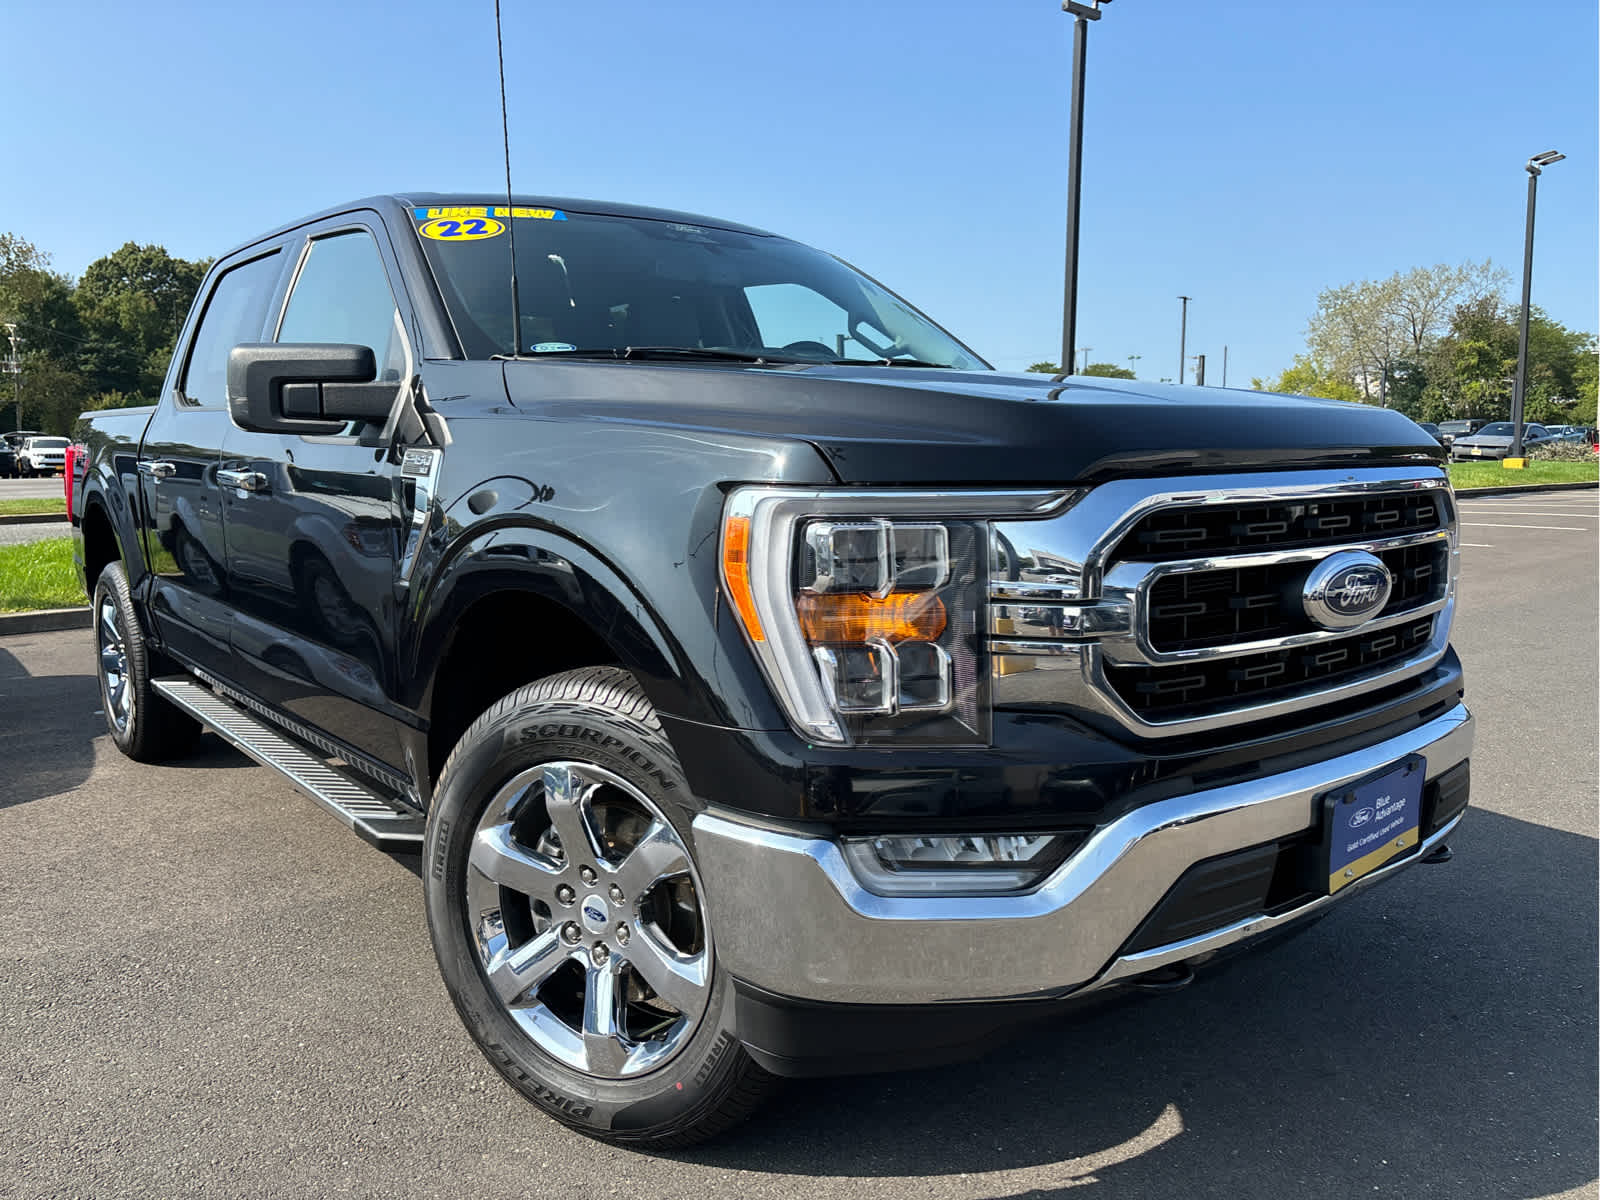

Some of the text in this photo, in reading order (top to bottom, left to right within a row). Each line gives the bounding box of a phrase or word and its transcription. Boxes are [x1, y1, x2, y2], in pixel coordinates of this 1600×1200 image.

[427, 207, 556, 219] LIKE NEW
[437, 219, 488, 237] 22
[1340, 573, 1379, 607] Ford
[518, 723, 677, 791] SCORPION
[1374, 798, 1406, 822] Advantage
[1375, 795, 1391, 809] Blue
[487, 1042, 594, 1119] PIRELLI
